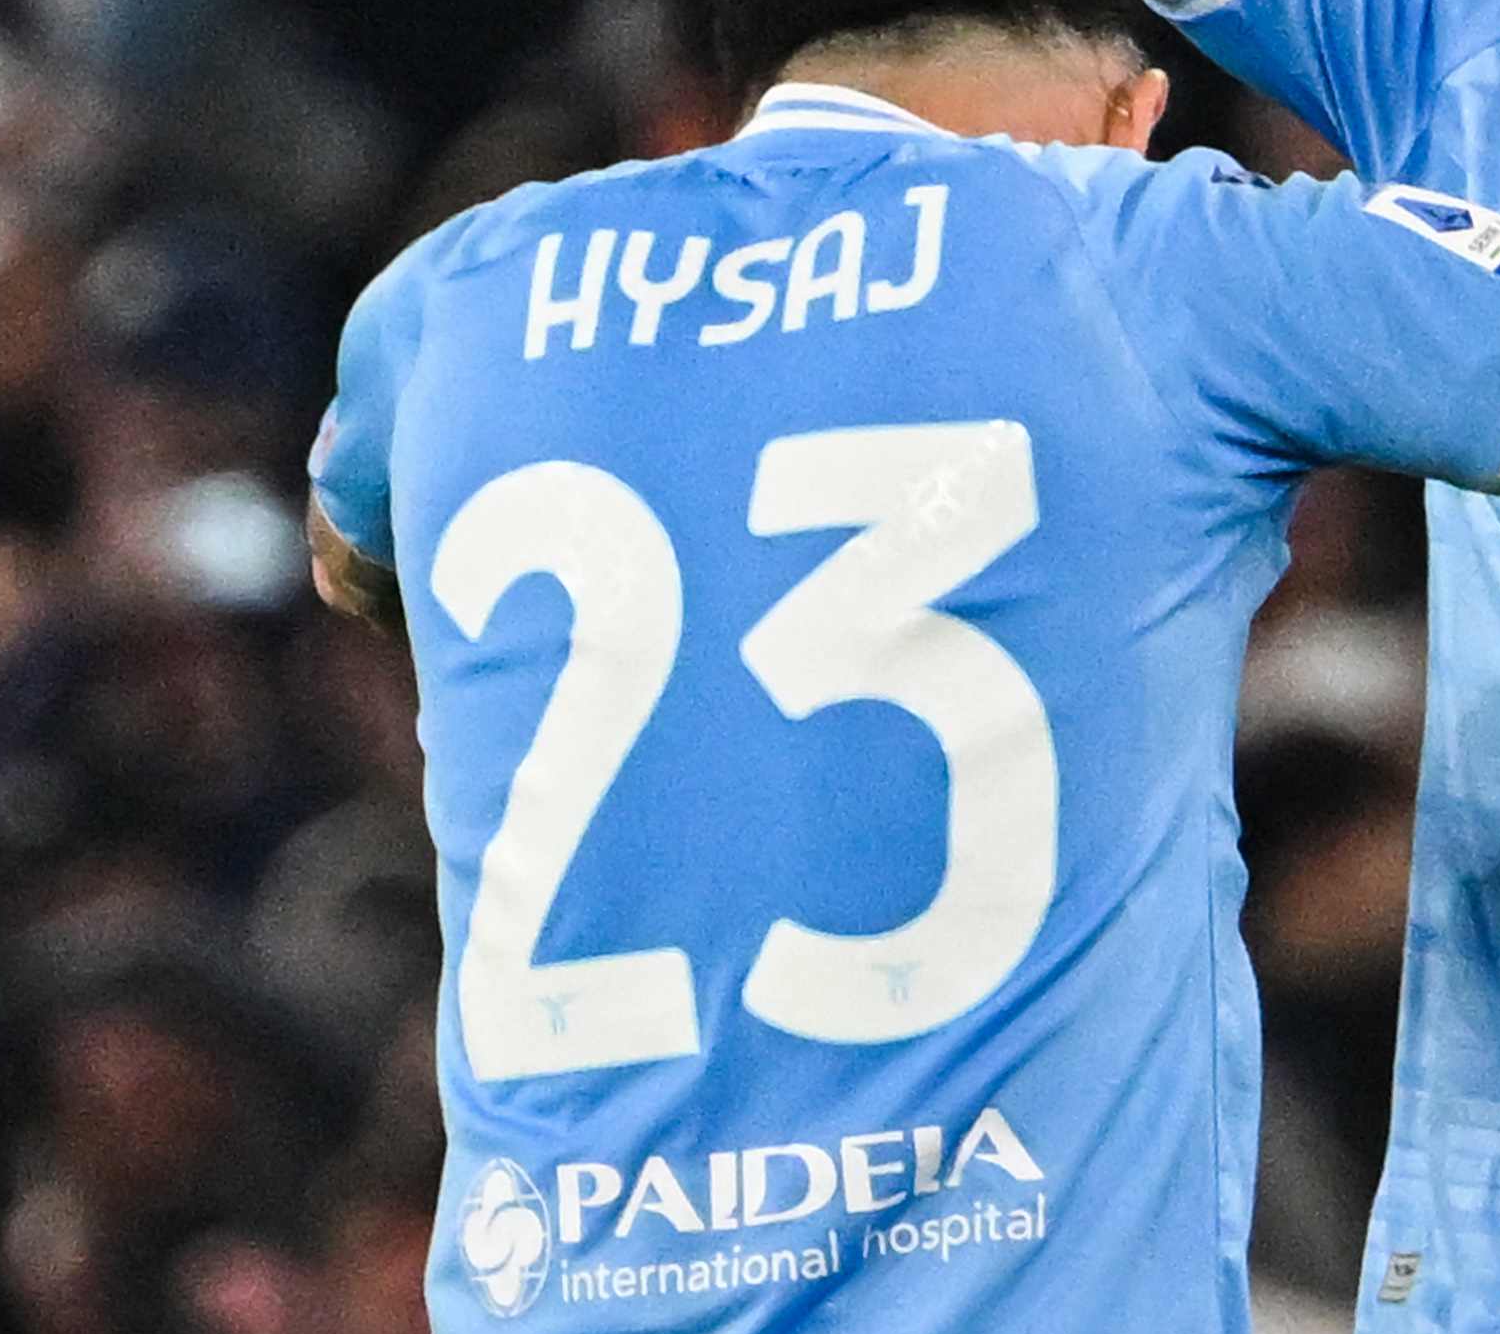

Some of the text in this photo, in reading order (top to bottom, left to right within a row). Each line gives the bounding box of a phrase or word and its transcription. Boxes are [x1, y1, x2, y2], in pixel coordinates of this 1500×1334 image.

[522, 183, 949, 361] HYSAJ
[430, 417, 1060, 1084] 23
[554, 1106, 1046, 1245] PAIDEIA
[561, 1194, 1047, 1304] international hospital
